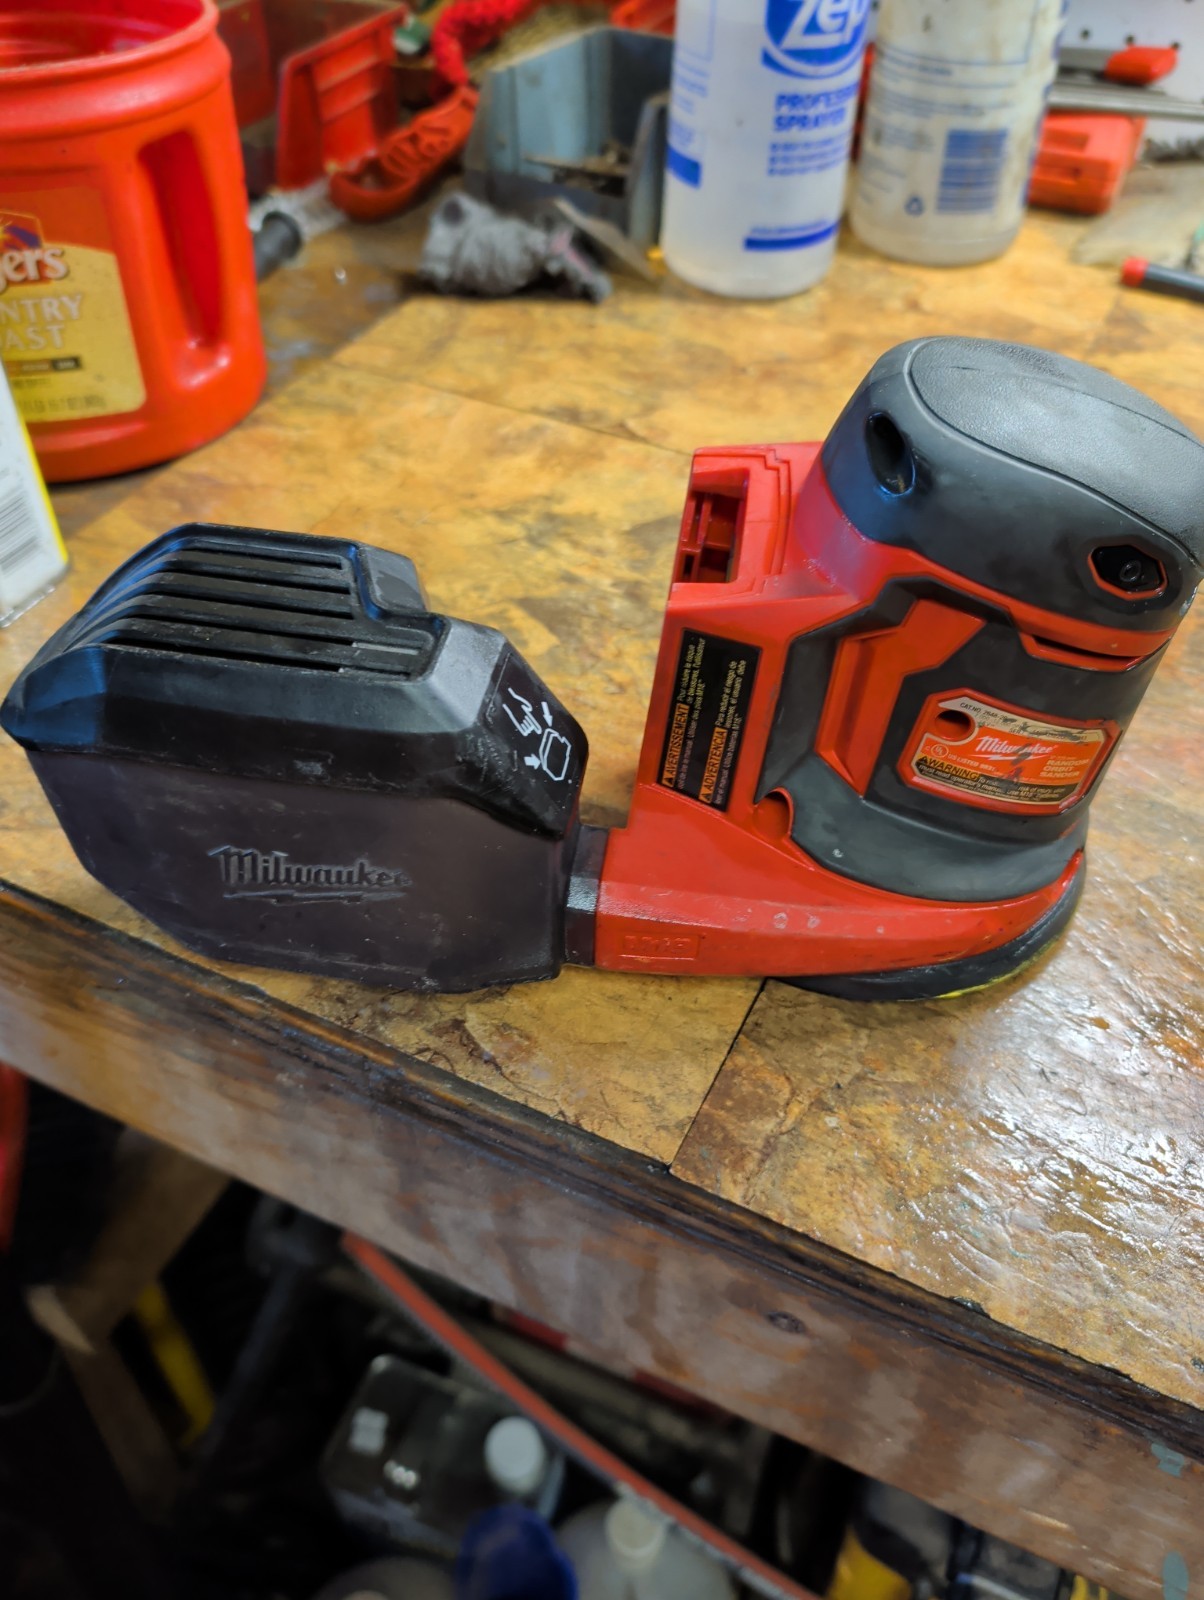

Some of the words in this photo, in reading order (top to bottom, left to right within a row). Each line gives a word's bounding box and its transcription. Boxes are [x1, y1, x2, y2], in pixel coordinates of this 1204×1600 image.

[668, 705, 689, 775] AVERTISSEMENT
[707, 730, 726, 791] ADVERTENCIA
[929, 759, 980, 781] WARNING
[1039, 771, 1080, 779] SANDER
[1042, 765, 1074, 773] ORBIT
[208, 845, 413, 888] Milwaukee
